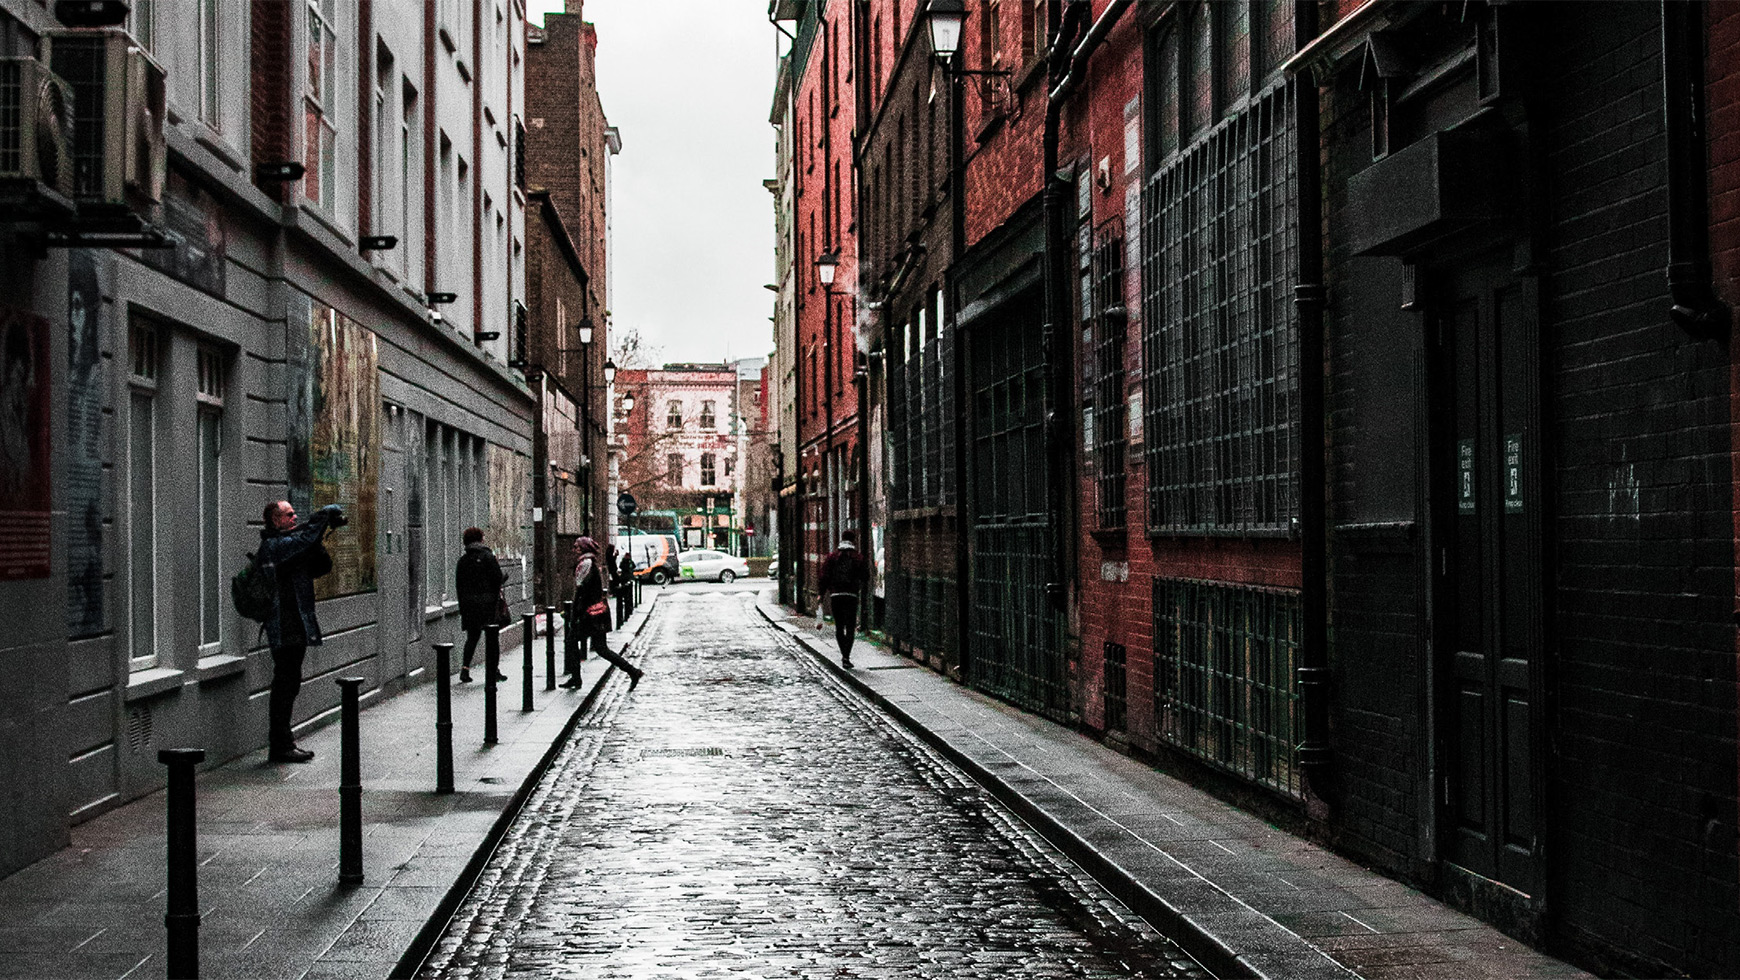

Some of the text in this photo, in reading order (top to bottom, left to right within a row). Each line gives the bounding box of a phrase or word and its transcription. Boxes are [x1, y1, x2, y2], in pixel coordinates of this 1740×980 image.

[1461, 445, 1472, 457] Fire
[1507, 440, 1519, 453] Fire
[1461, 458, 1472, 469] exit
[1507, 453, 1519, 466] exit
